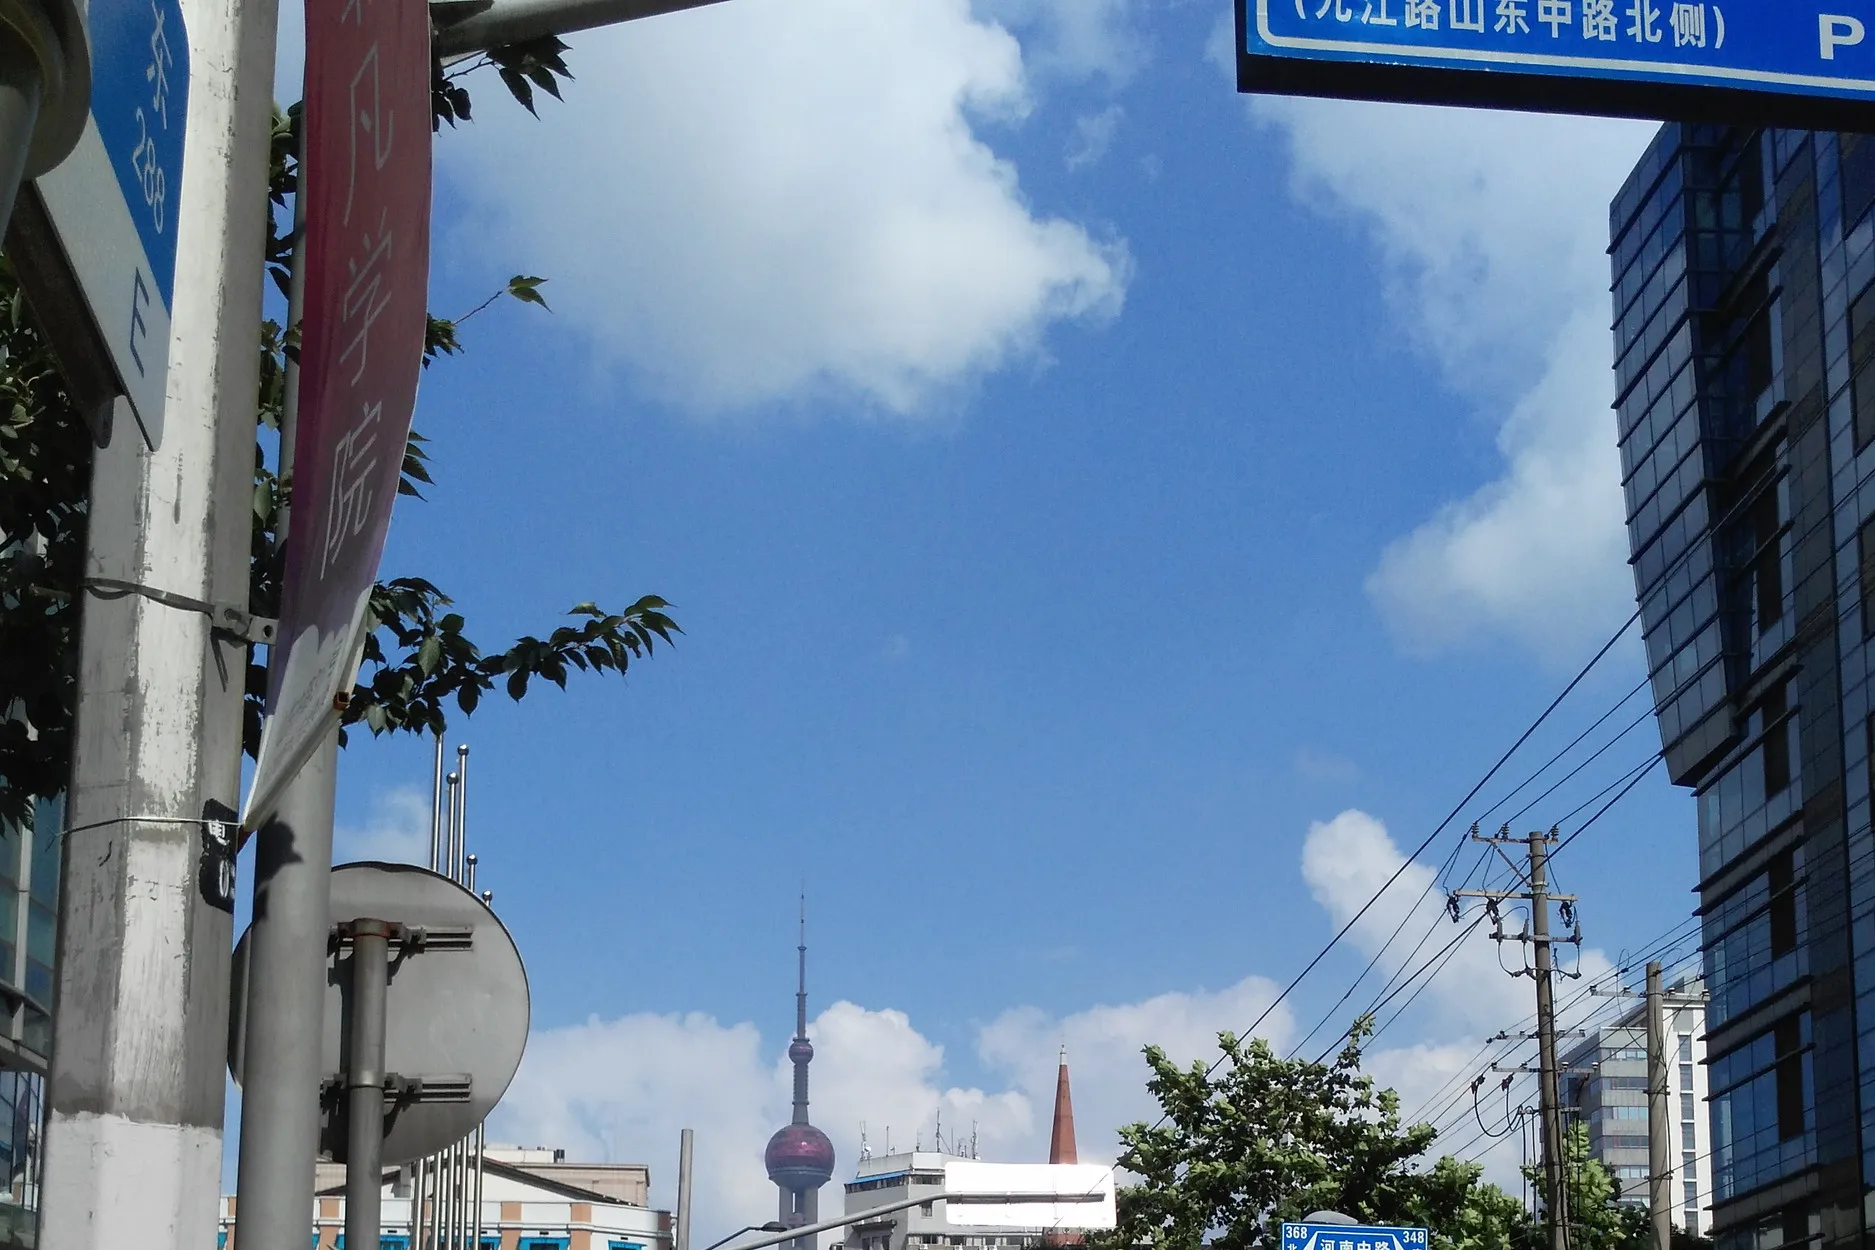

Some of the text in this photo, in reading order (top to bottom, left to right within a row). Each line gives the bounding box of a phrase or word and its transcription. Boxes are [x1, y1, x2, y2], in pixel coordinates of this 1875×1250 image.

[1818, 13, 1865, 61] P
[132, 106, 165, 234] 288
[130, 266, 150, 379] E
[319, 0, 396, 581] 凡学院
[1285, 1226, 1308, 1240] 368
[1402, 1231, 1425, 1244] 348
